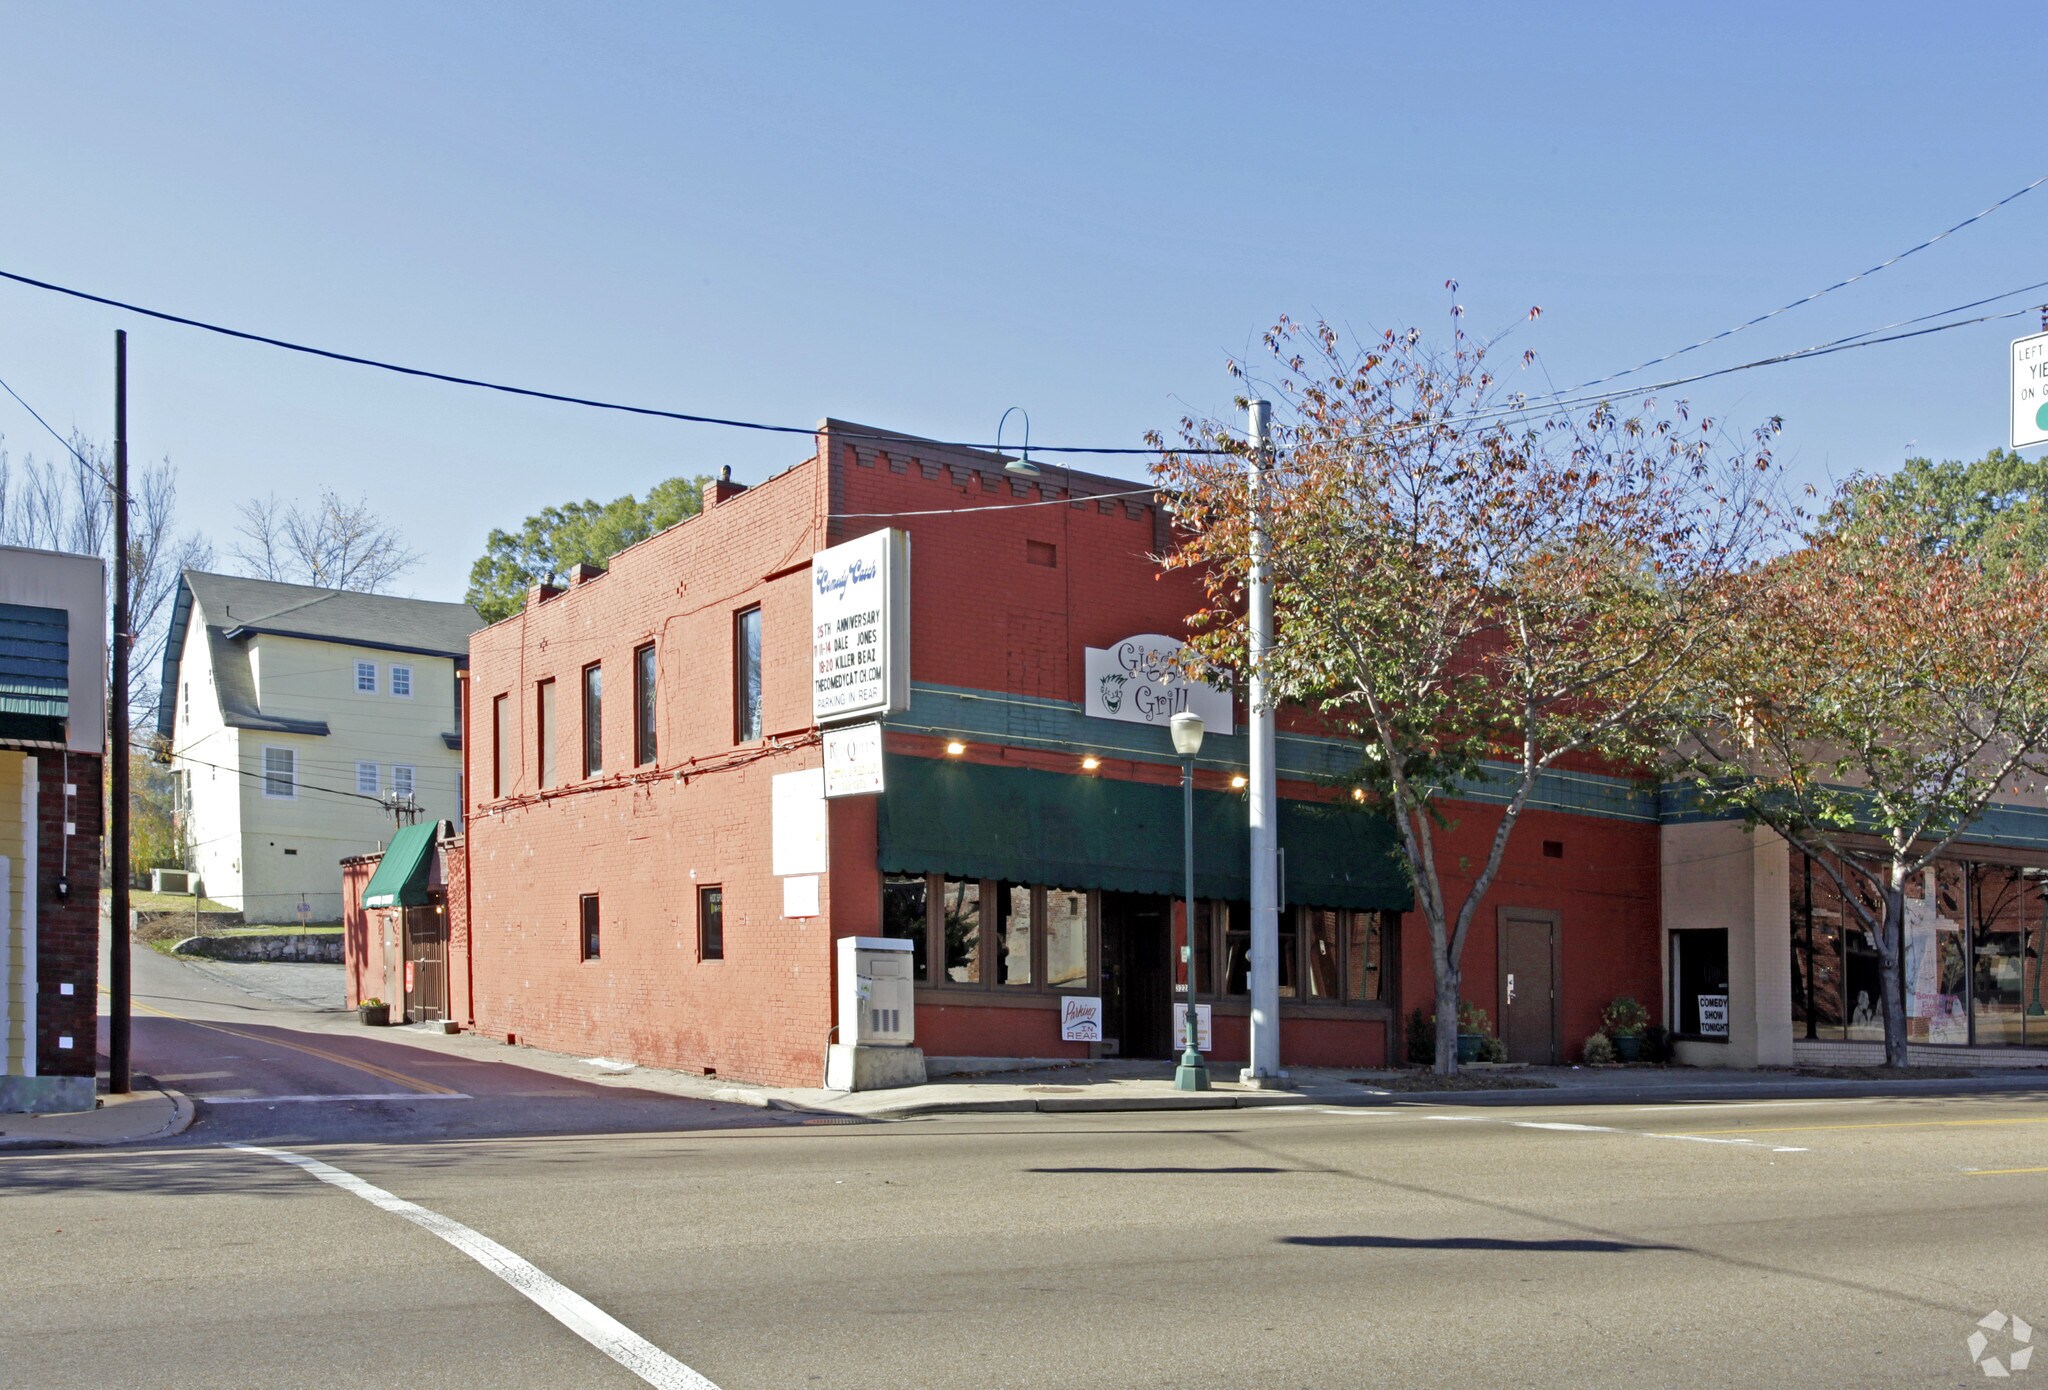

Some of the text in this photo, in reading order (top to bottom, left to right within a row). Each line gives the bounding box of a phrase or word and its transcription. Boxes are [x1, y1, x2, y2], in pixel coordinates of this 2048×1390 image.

[2019, 344, 2043, 361] LEFT
[2021, 387, 2035, 400] ON
[816, 569, 849, 601] Comedy
[817, 609, 880, 638] 25TH ANNIVERSARY
[834, 635, 848, 652] DALE
[857, 629, 877, 646] JONES
[819, 648, 876, 674] 18-20 KILLER BEAZ
[1118, 642, 1192, 684] Giggl
[817, 687, 878, 709] PARKING IN REAR
[1135, 685, 1189, 721] Grill
[1062, 1000, 1097, 1024] Parking
[1700, 998, 1728, 1007] COMEDY
[1704, 1010, 1723, 1020] SHOW
[1067, 1031, 1098, 1040] REAR
[1701, 1023, 1728, 1032] TONIGHT
